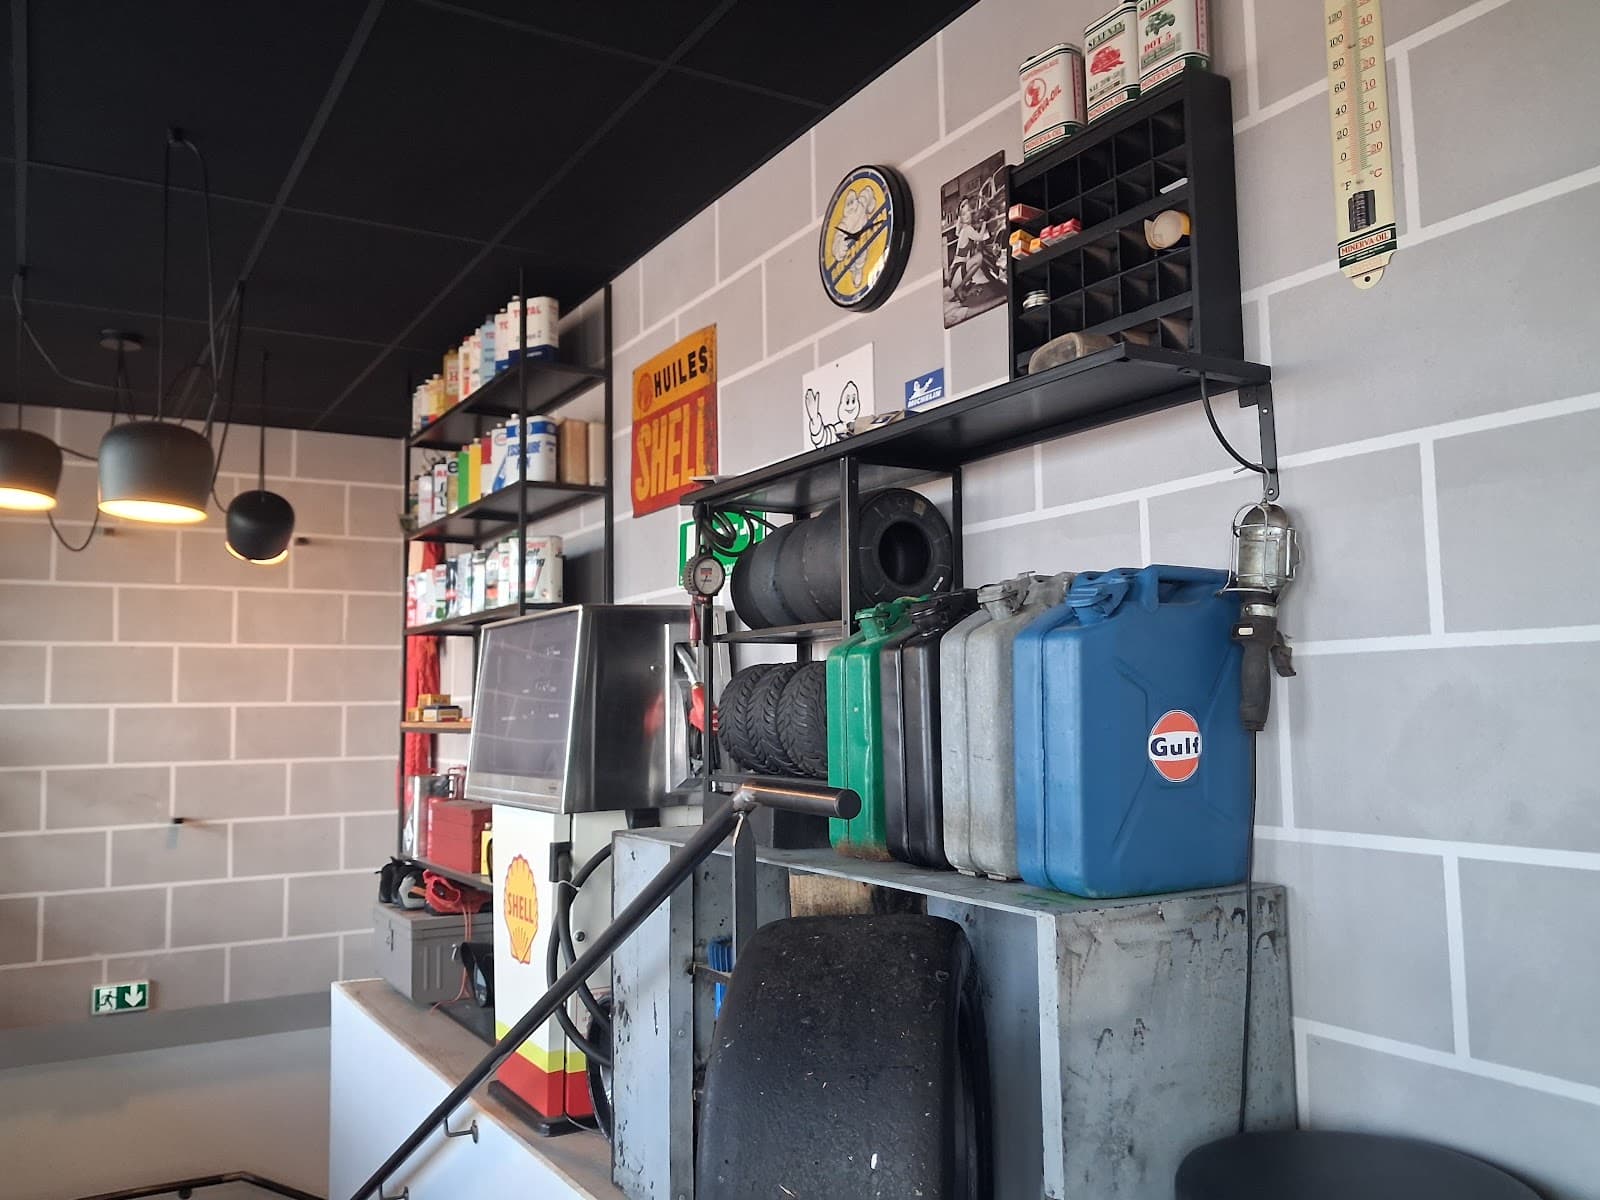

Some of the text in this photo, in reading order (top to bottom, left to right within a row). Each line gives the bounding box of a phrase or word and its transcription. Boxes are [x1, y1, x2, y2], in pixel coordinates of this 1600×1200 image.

[1328, 10, 1343, 25] 120
[1360, 13, 1373, 26] 40
[1330, 33, 1344, 48] 100
[1361, 35, 1374, 48] 30
[1332, 57, 1345, 70] 80
[1362, 56, 1376, 71] 20
[1334, 80, 1346, 93] 60
[1364, 78, 1376, 91] 10
[1335, 104, 1347, 116] 40
[1368, 101, 1375, 111] 0
[1336, 127, 1349, 140] 20
[1340, 152, 1347, 161] 0
[654, 345, 708, 398] HUILES
[907, 389, 942, 409] MICHELIN
[635, 396, 706, 501] SHELL
[1150, 736, 1199, 757] Gulf
[508, 892, 534, 925] SHELL
